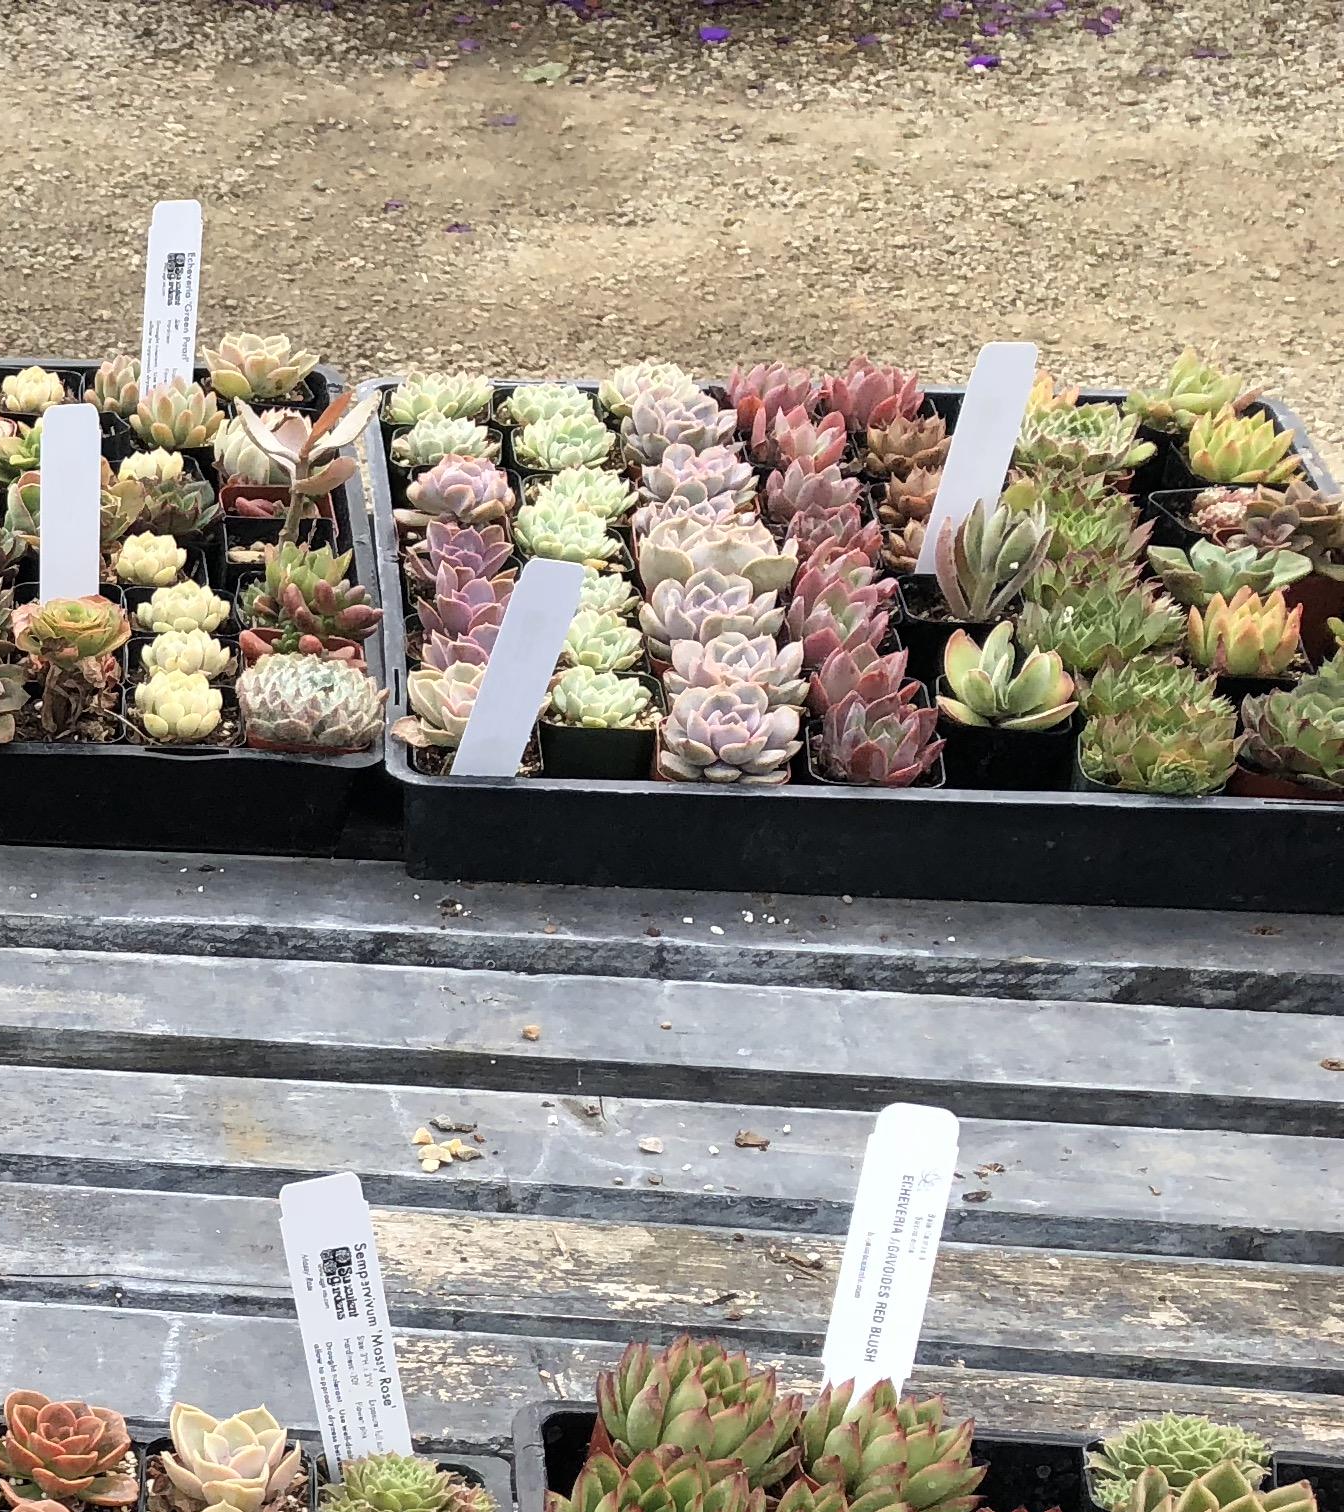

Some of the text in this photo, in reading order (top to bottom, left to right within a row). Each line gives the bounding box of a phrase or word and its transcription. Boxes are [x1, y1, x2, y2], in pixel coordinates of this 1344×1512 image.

[184, 252, 197, 299] Echeveria
[891, 1174, 915, 1234] ECHEVERIA
[872, 1301, 888, 1324] RED
[863, 1326, 882, 1363] BLUSH
[379, 1377, 397, 1409] Rose'
